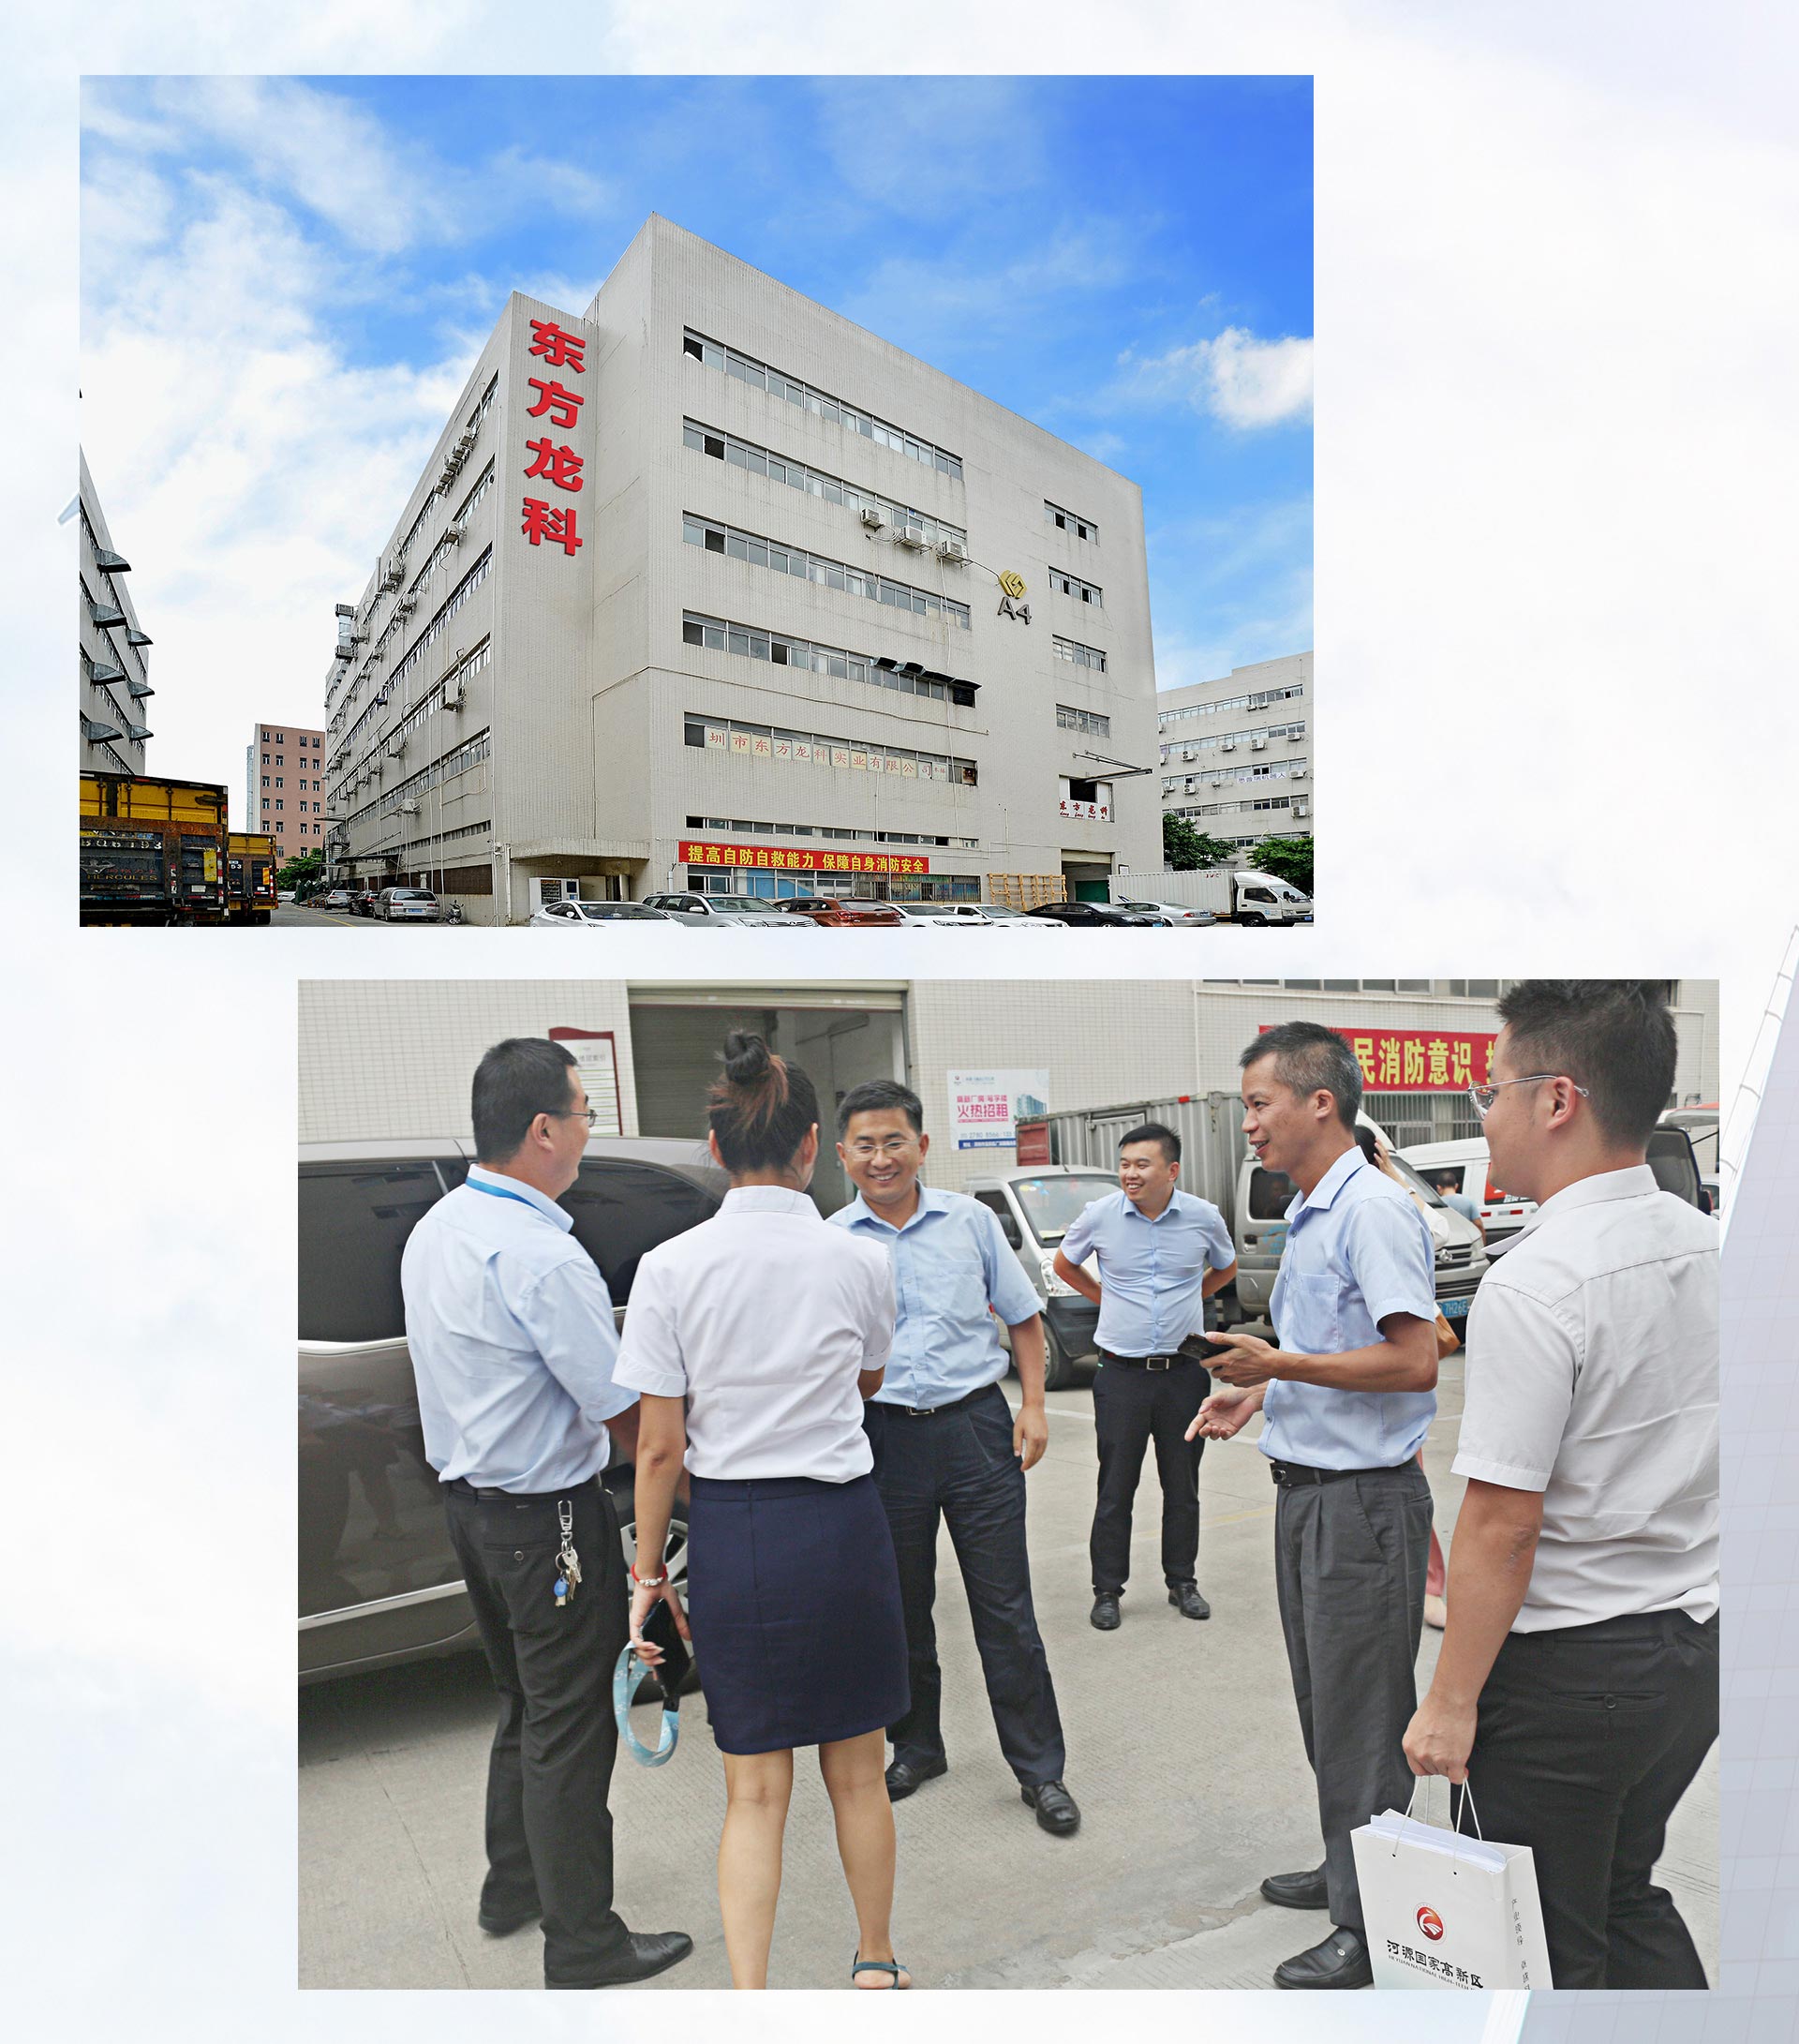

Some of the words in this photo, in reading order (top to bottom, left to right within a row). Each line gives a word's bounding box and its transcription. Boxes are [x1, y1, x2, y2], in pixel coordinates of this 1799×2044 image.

[521, 319, 587, 557] 东方龙科
[997, 596, 1033, 625] A4
[687, 844, 815, 870] 提高自防自救能力
[822, 853, 925, 873] 保障自身消防安全
[1354, 1037, 1473, 1085] 民消防意识
[958, 1104, 1008, 1118] 火热招租
[1387, 1939, 1483, 1989] 河源国家高新区
